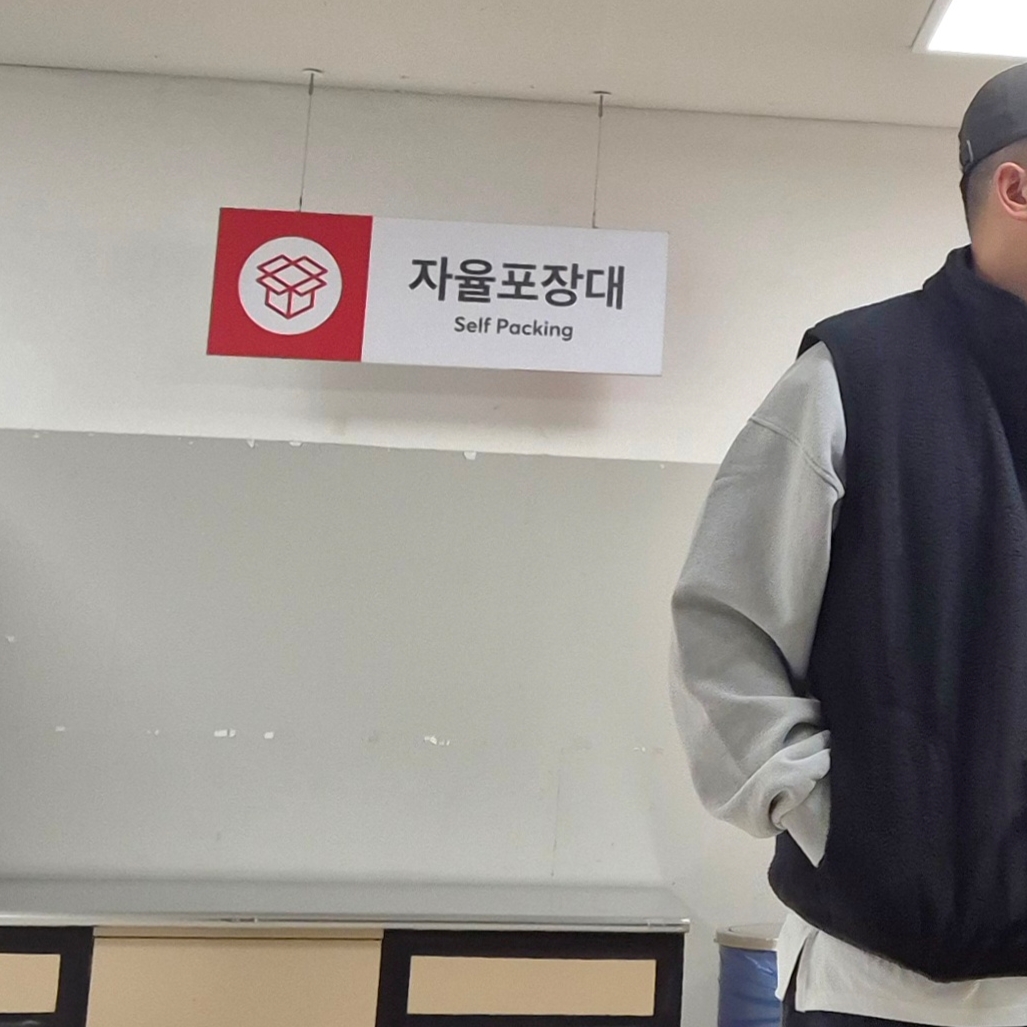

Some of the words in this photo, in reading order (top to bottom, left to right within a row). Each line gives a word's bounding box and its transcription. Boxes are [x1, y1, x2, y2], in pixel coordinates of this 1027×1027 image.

[408, 256, 625, 310] 자율포장대
[454, 316, 492, 333] Self
[496, 318, 574, 341] Packing
